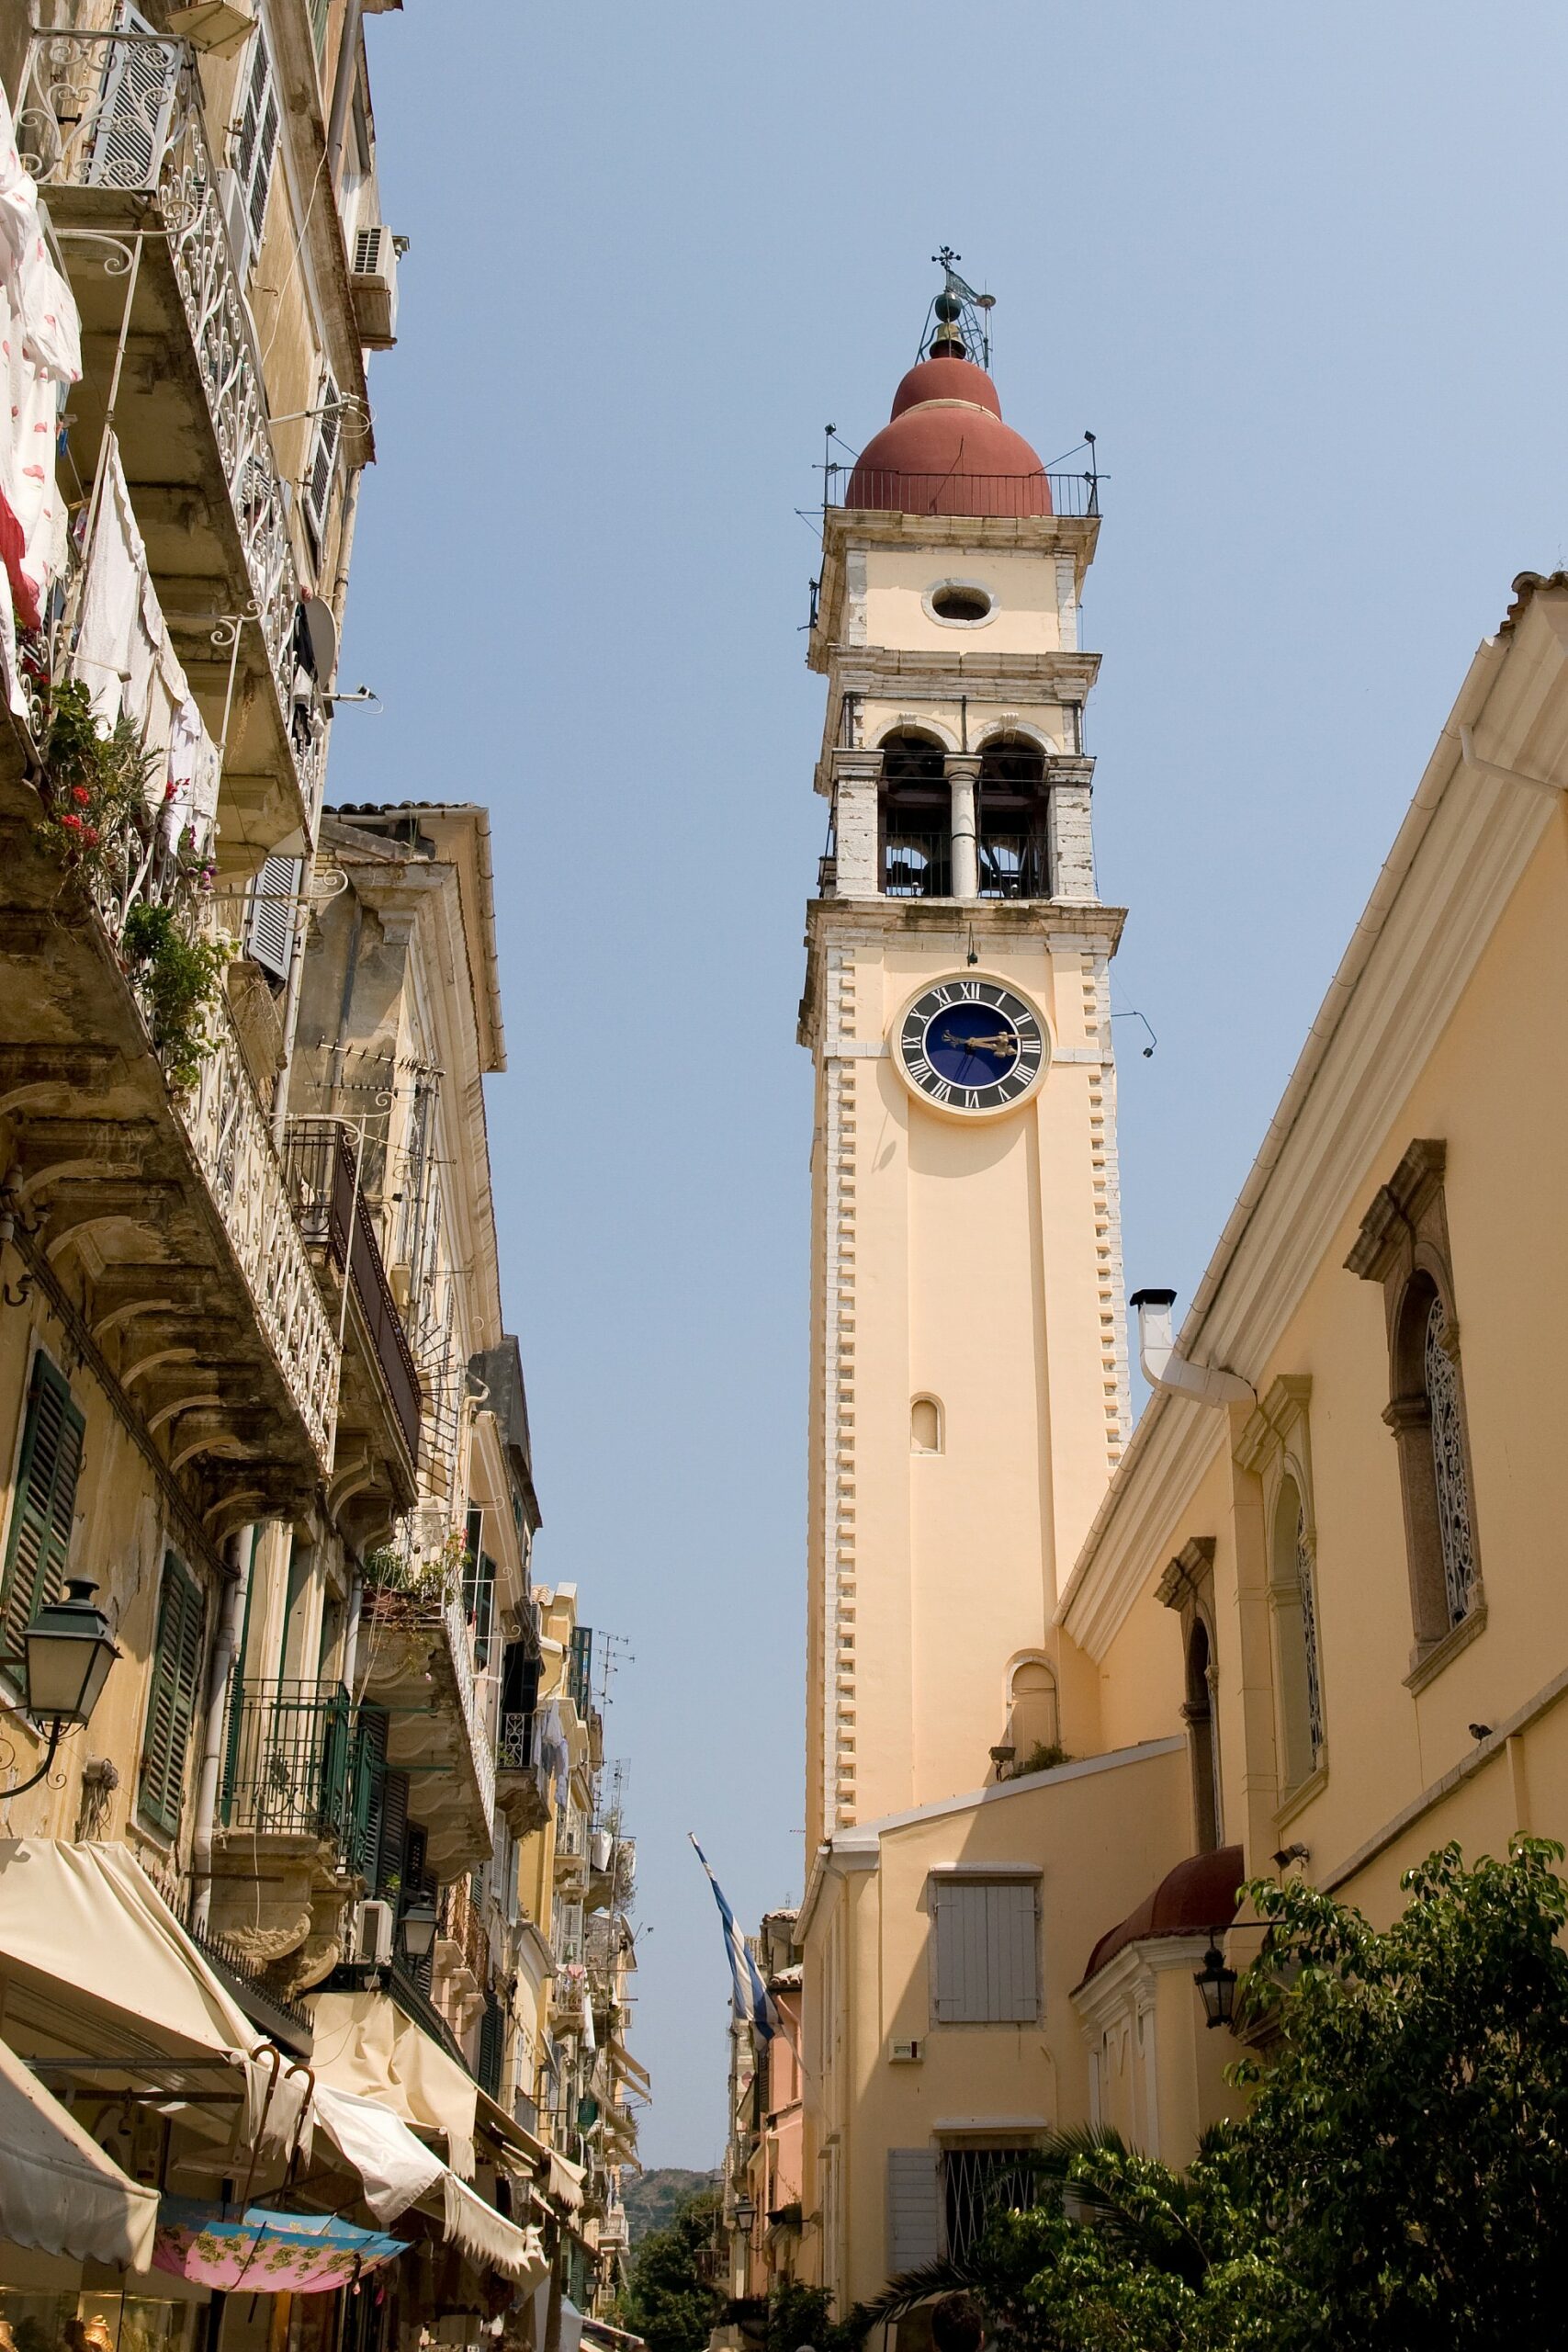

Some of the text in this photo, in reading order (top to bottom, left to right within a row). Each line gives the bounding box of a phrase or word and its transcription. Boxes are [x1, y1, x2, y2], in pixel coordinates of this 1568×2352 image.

[931, 987, 953, 1006] XI
[960, 983, 980, 1000] XII
[995, 992, 1007, 1006] I
[910, 1009, 930, 1023] X
[1014, 1012, 1032, 1025] II
[903, 1035, 921, 1049] IX
[1021, 1040, 1041, 1054] III
[908, 1058, 931, 1085] VIII
[1012, 1062, 1036, 1085] IIII
[931, 1080, 952, 1102] VII
[964, 1091, 979, 1108] VI
[998, 1085, 1011, 1102] V
